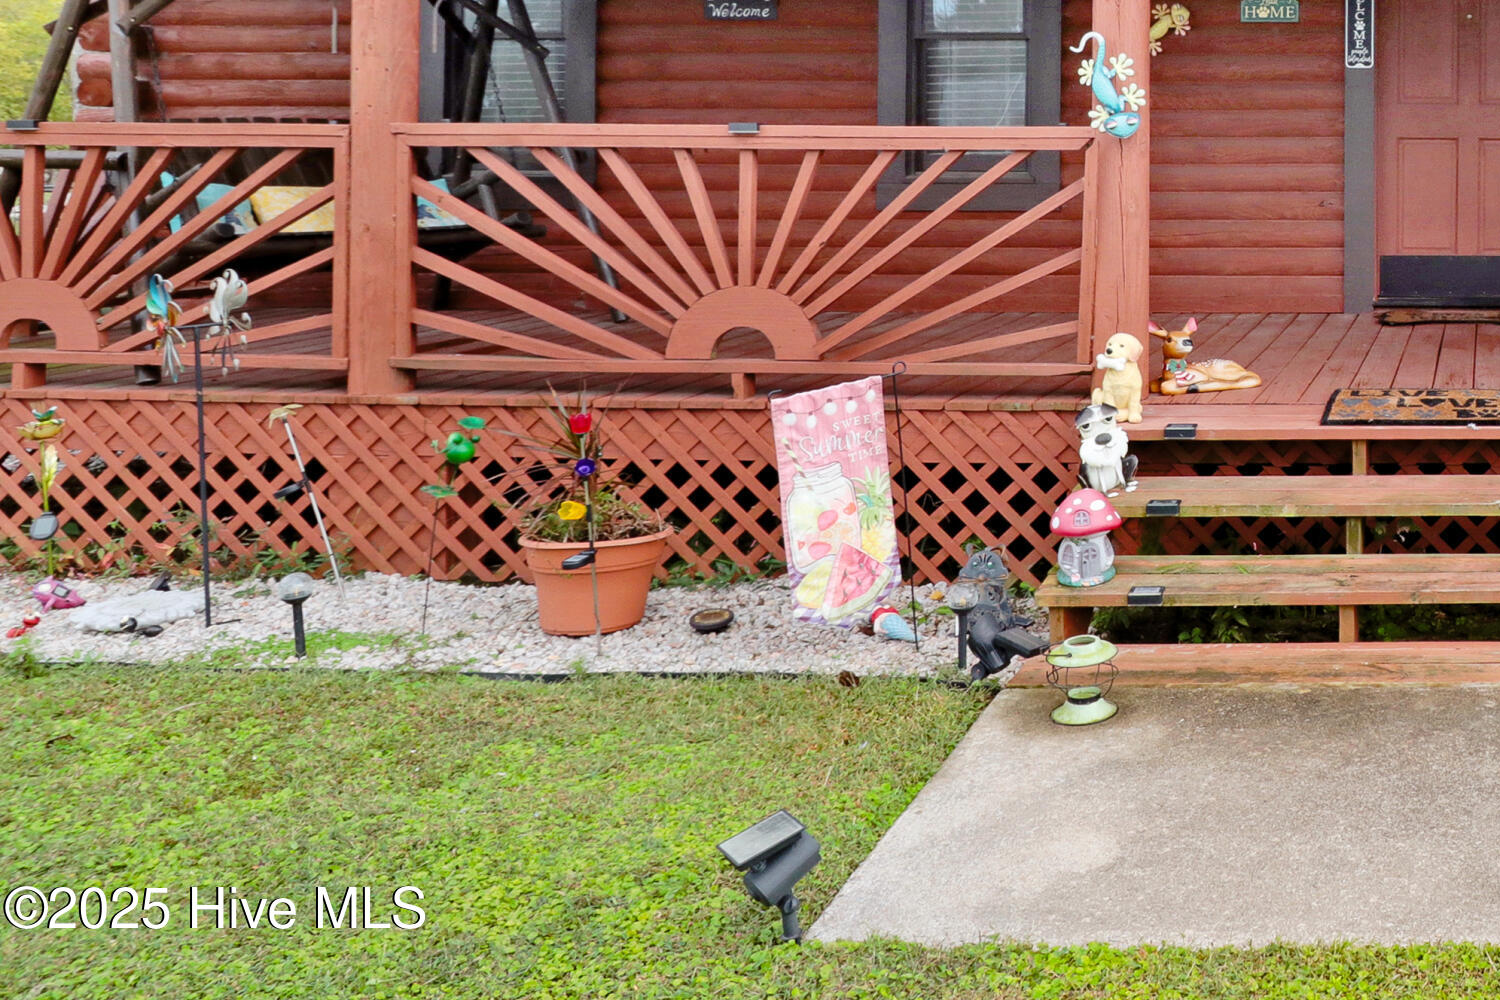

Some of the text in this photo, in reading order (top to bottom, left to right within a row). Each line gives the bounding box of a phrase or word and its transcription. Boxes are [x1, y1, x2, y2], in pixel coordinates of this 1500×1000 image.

[708, 3, 770, 17] Welcome
[1350, 389, 1449, 397] LIVE
[832, 411, 881, 432] SWEET
[799, 426, 884, 463] Summer
[848, 445, 882, 463] TIME
